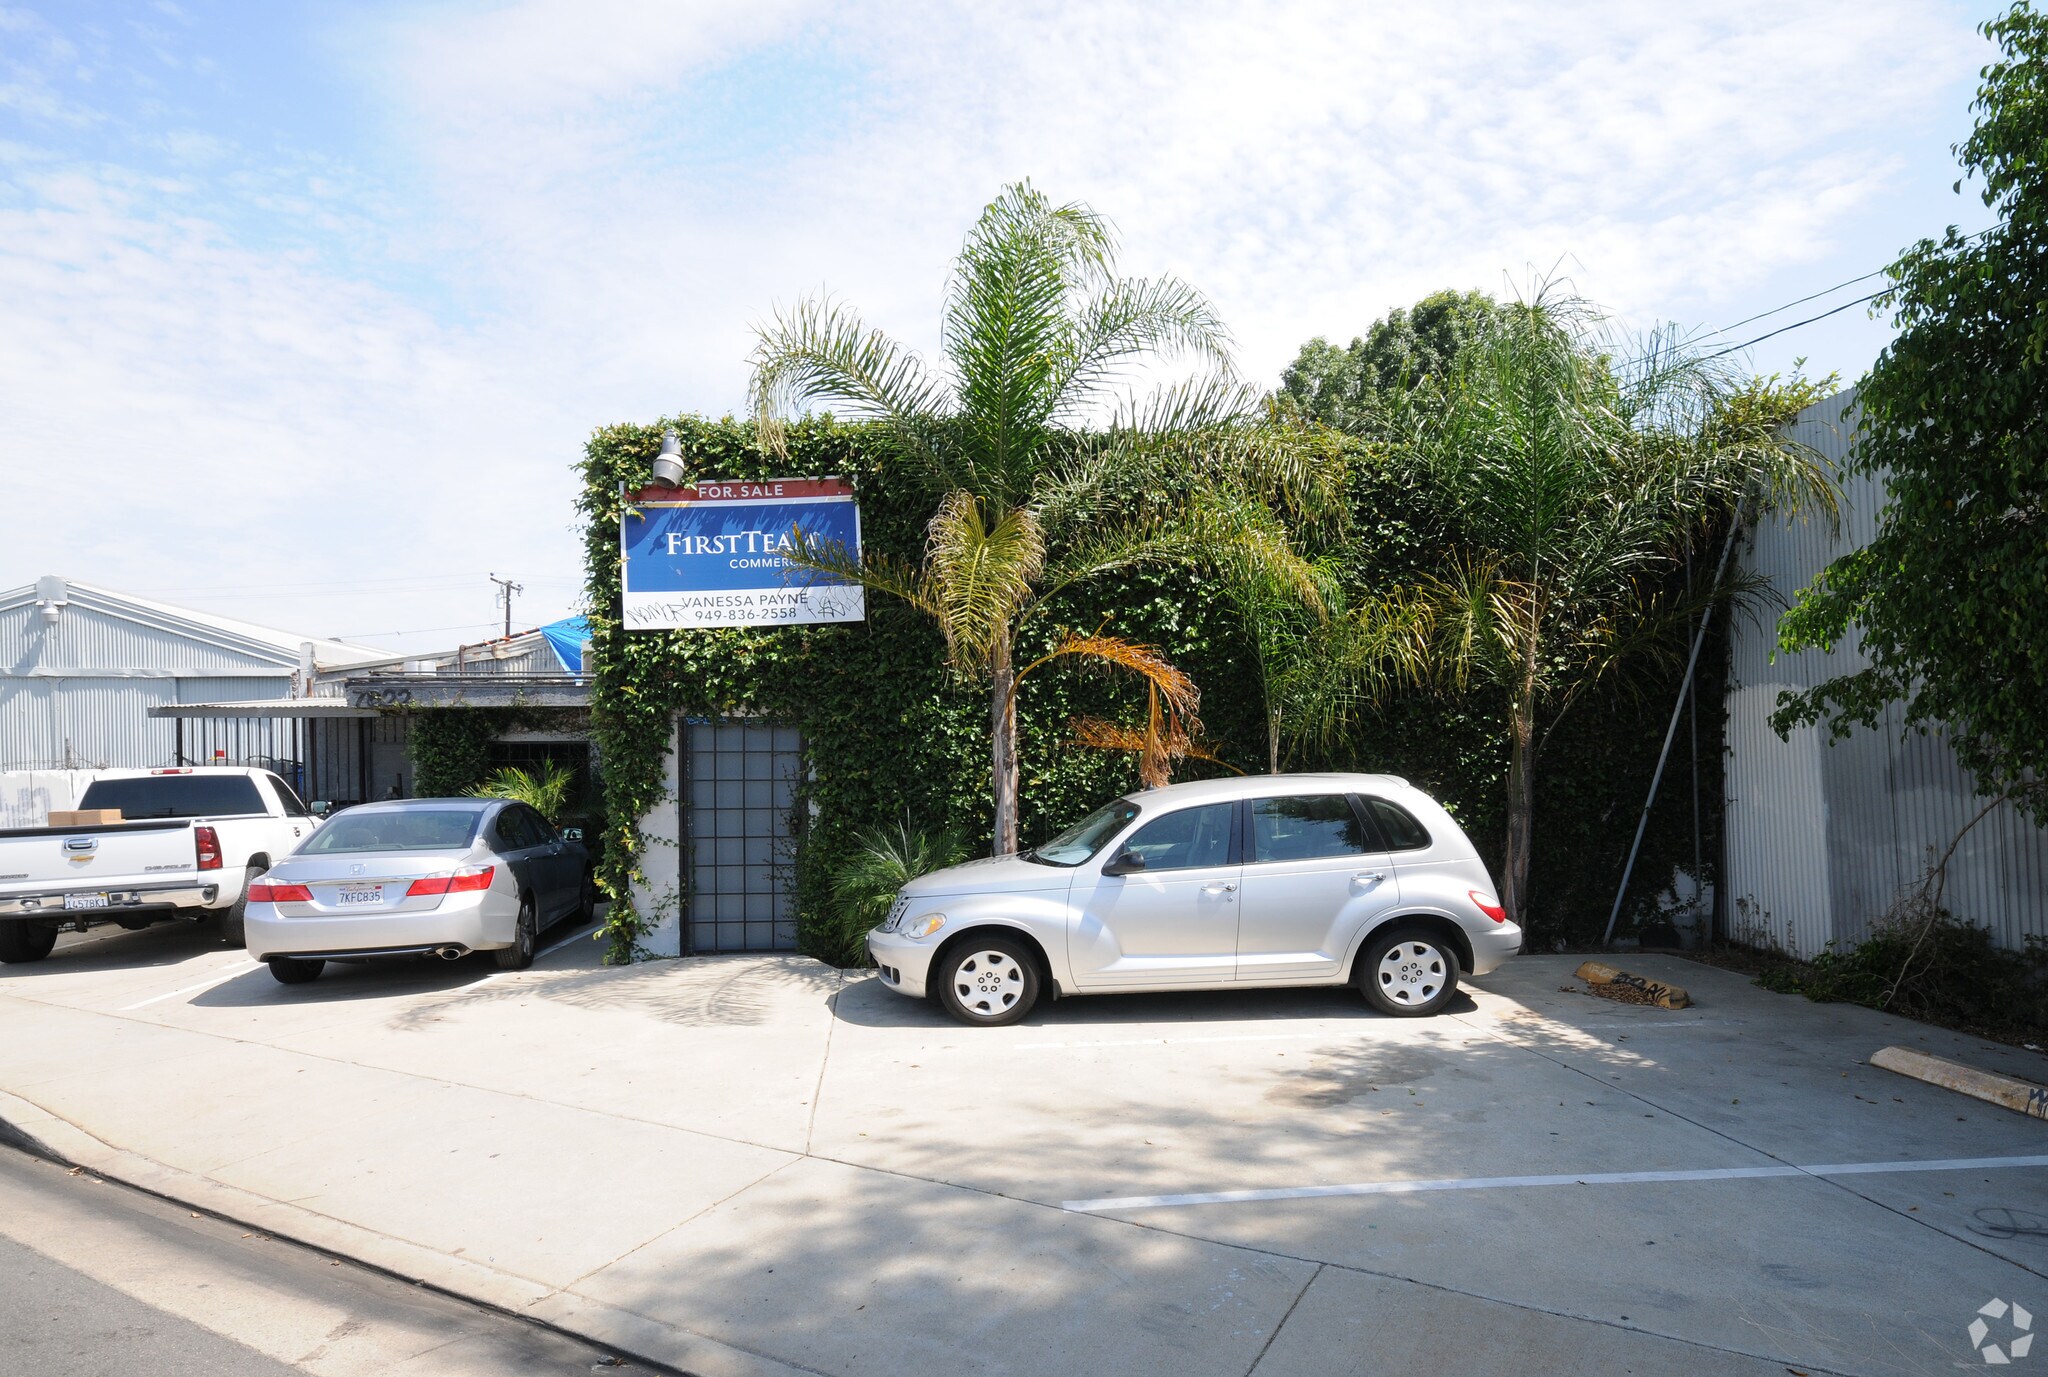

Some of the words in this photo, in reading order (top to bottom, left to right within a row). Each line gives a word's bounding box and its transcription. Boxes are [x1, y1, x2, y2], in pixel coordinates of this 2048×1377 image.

[741, 484, 784, 497] SALE
[682, 595, 754, 608] VANESSA
[760, 593, 808, 606] PAYNE
[695, 607, 797, 621] 949-836-2558
[67, 898, 106, 910] 14578K1
[339, 892, 381, 903] 7KFC835
